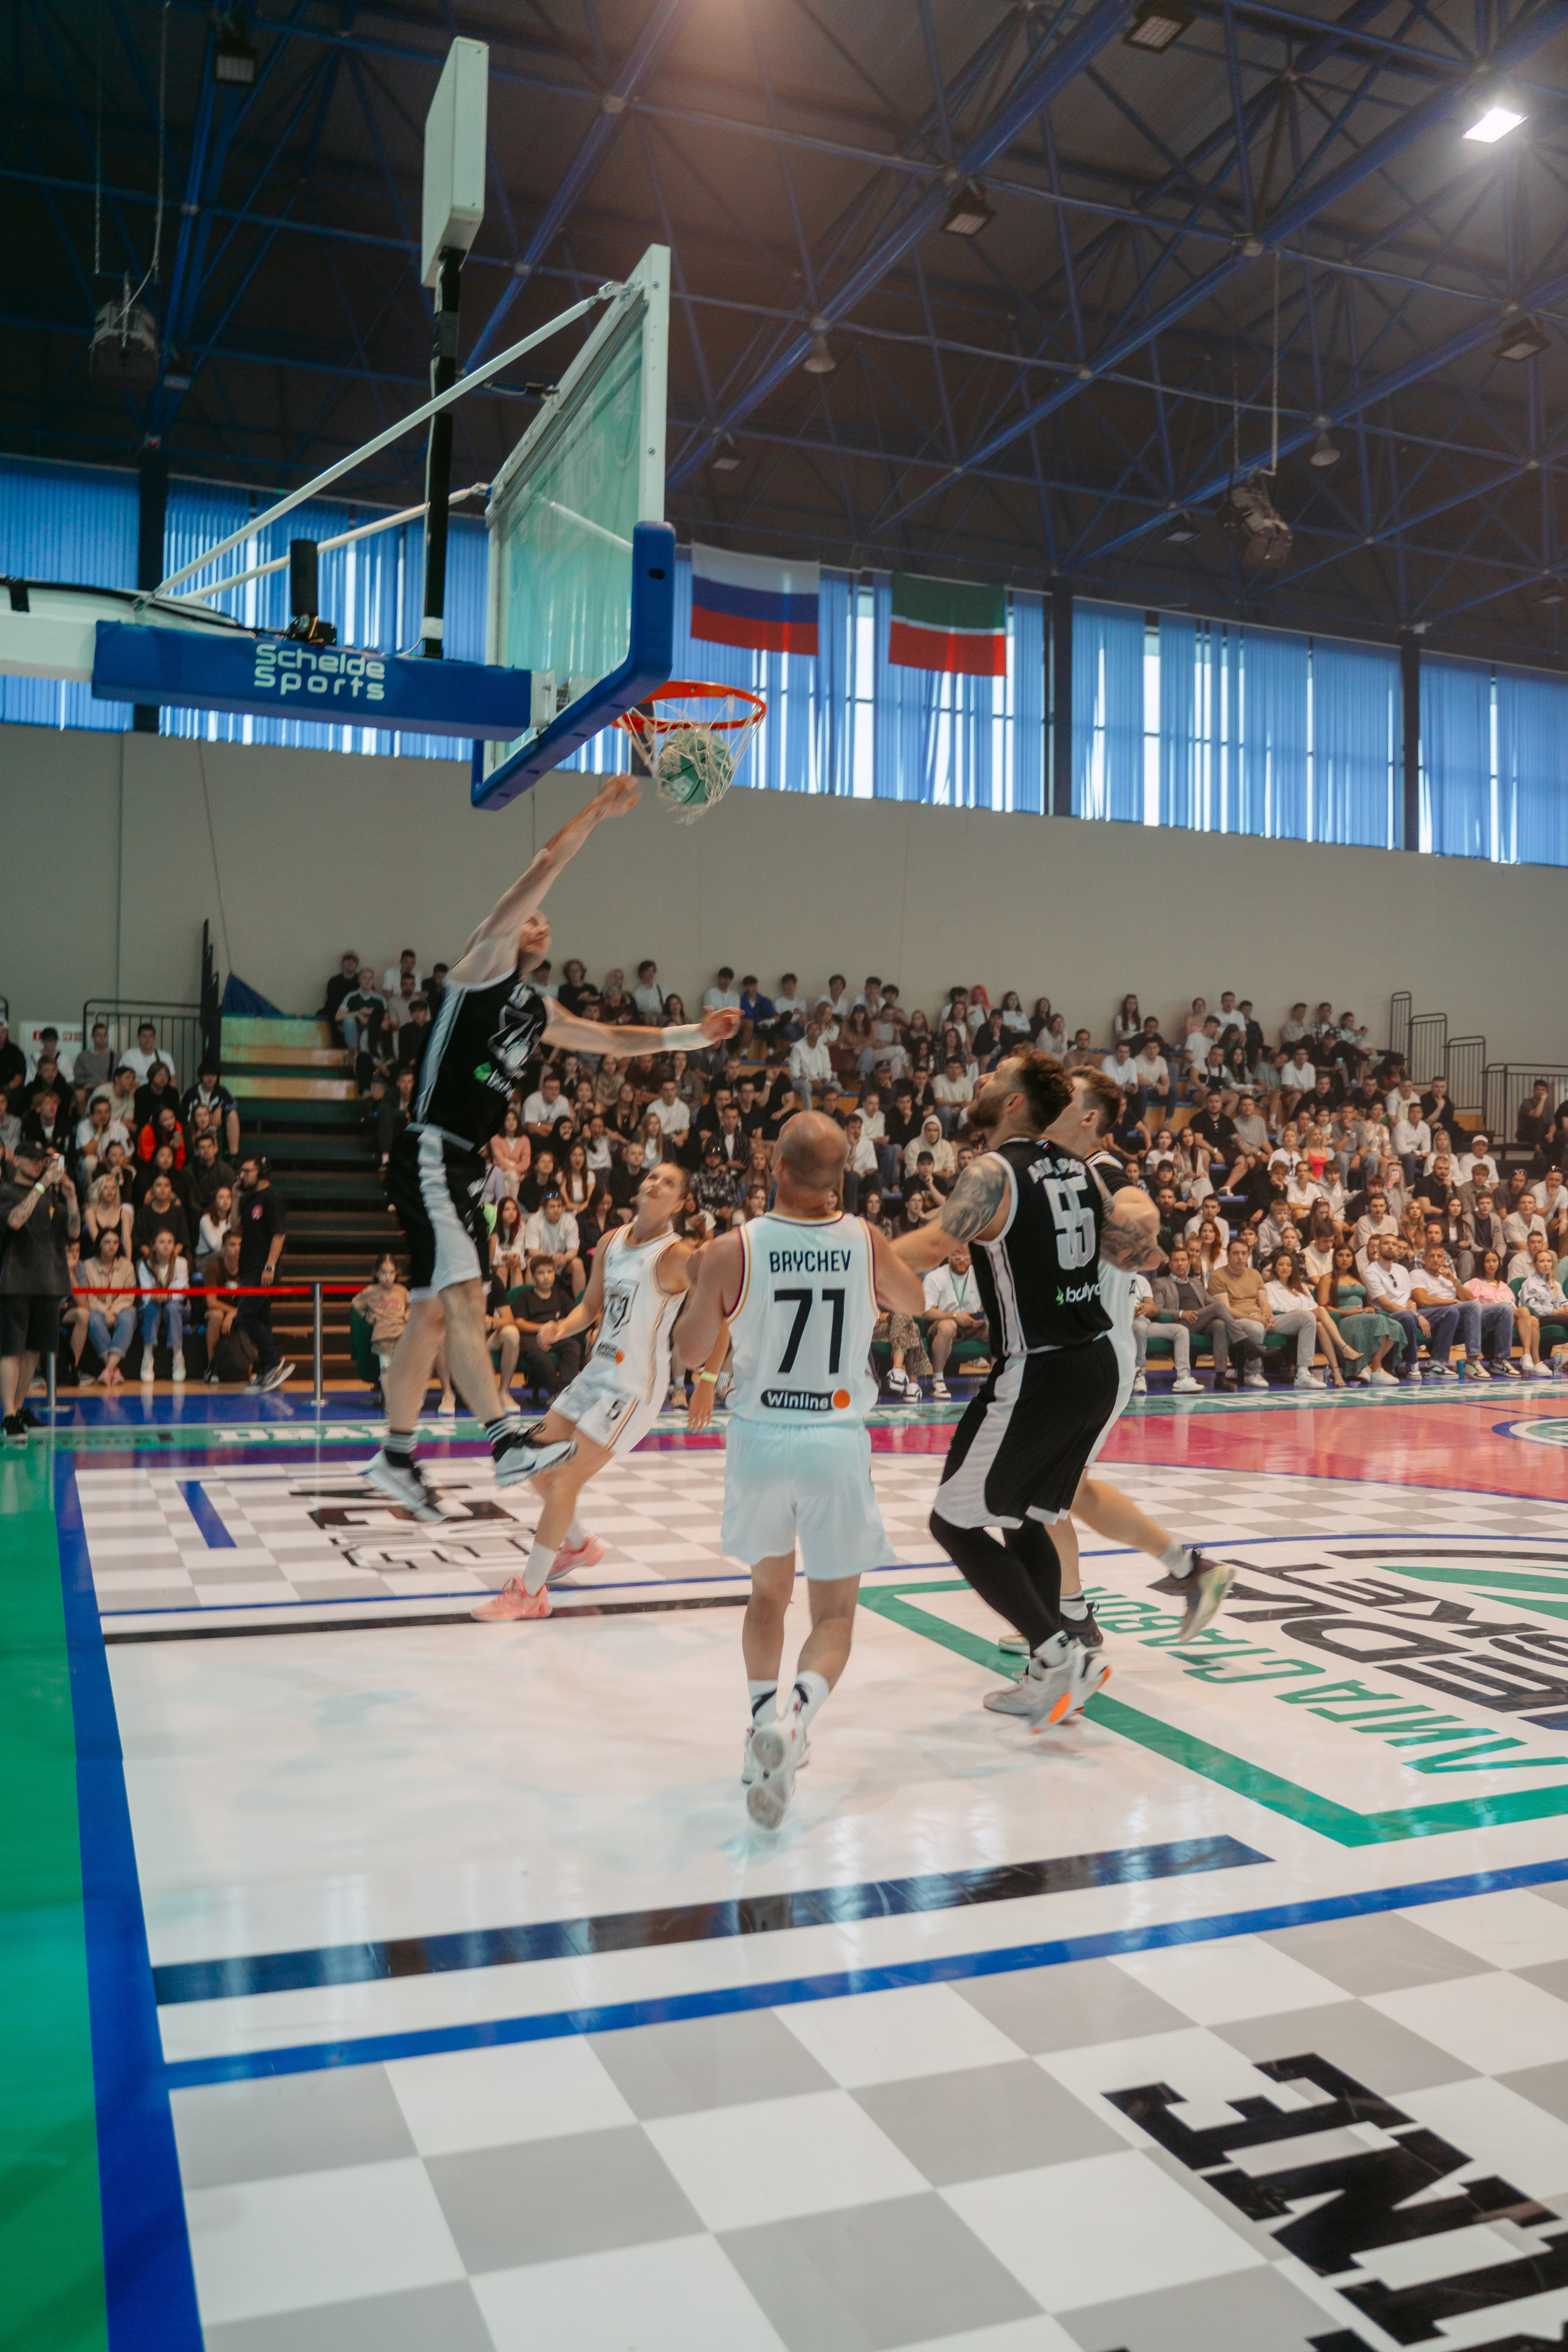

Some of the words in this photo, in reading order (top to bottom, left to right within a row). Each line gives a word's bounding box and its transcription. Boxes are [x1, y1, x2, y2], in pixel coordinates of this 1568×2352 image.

[255, 643, 385, 680] Schelde
[254, 666, 385, 701] Sports
[769, 1250, 851, 1273] BRYCHEV
[774, 1288, 846, 1375] 71
[767, 1390, 829, 1410] Winline
